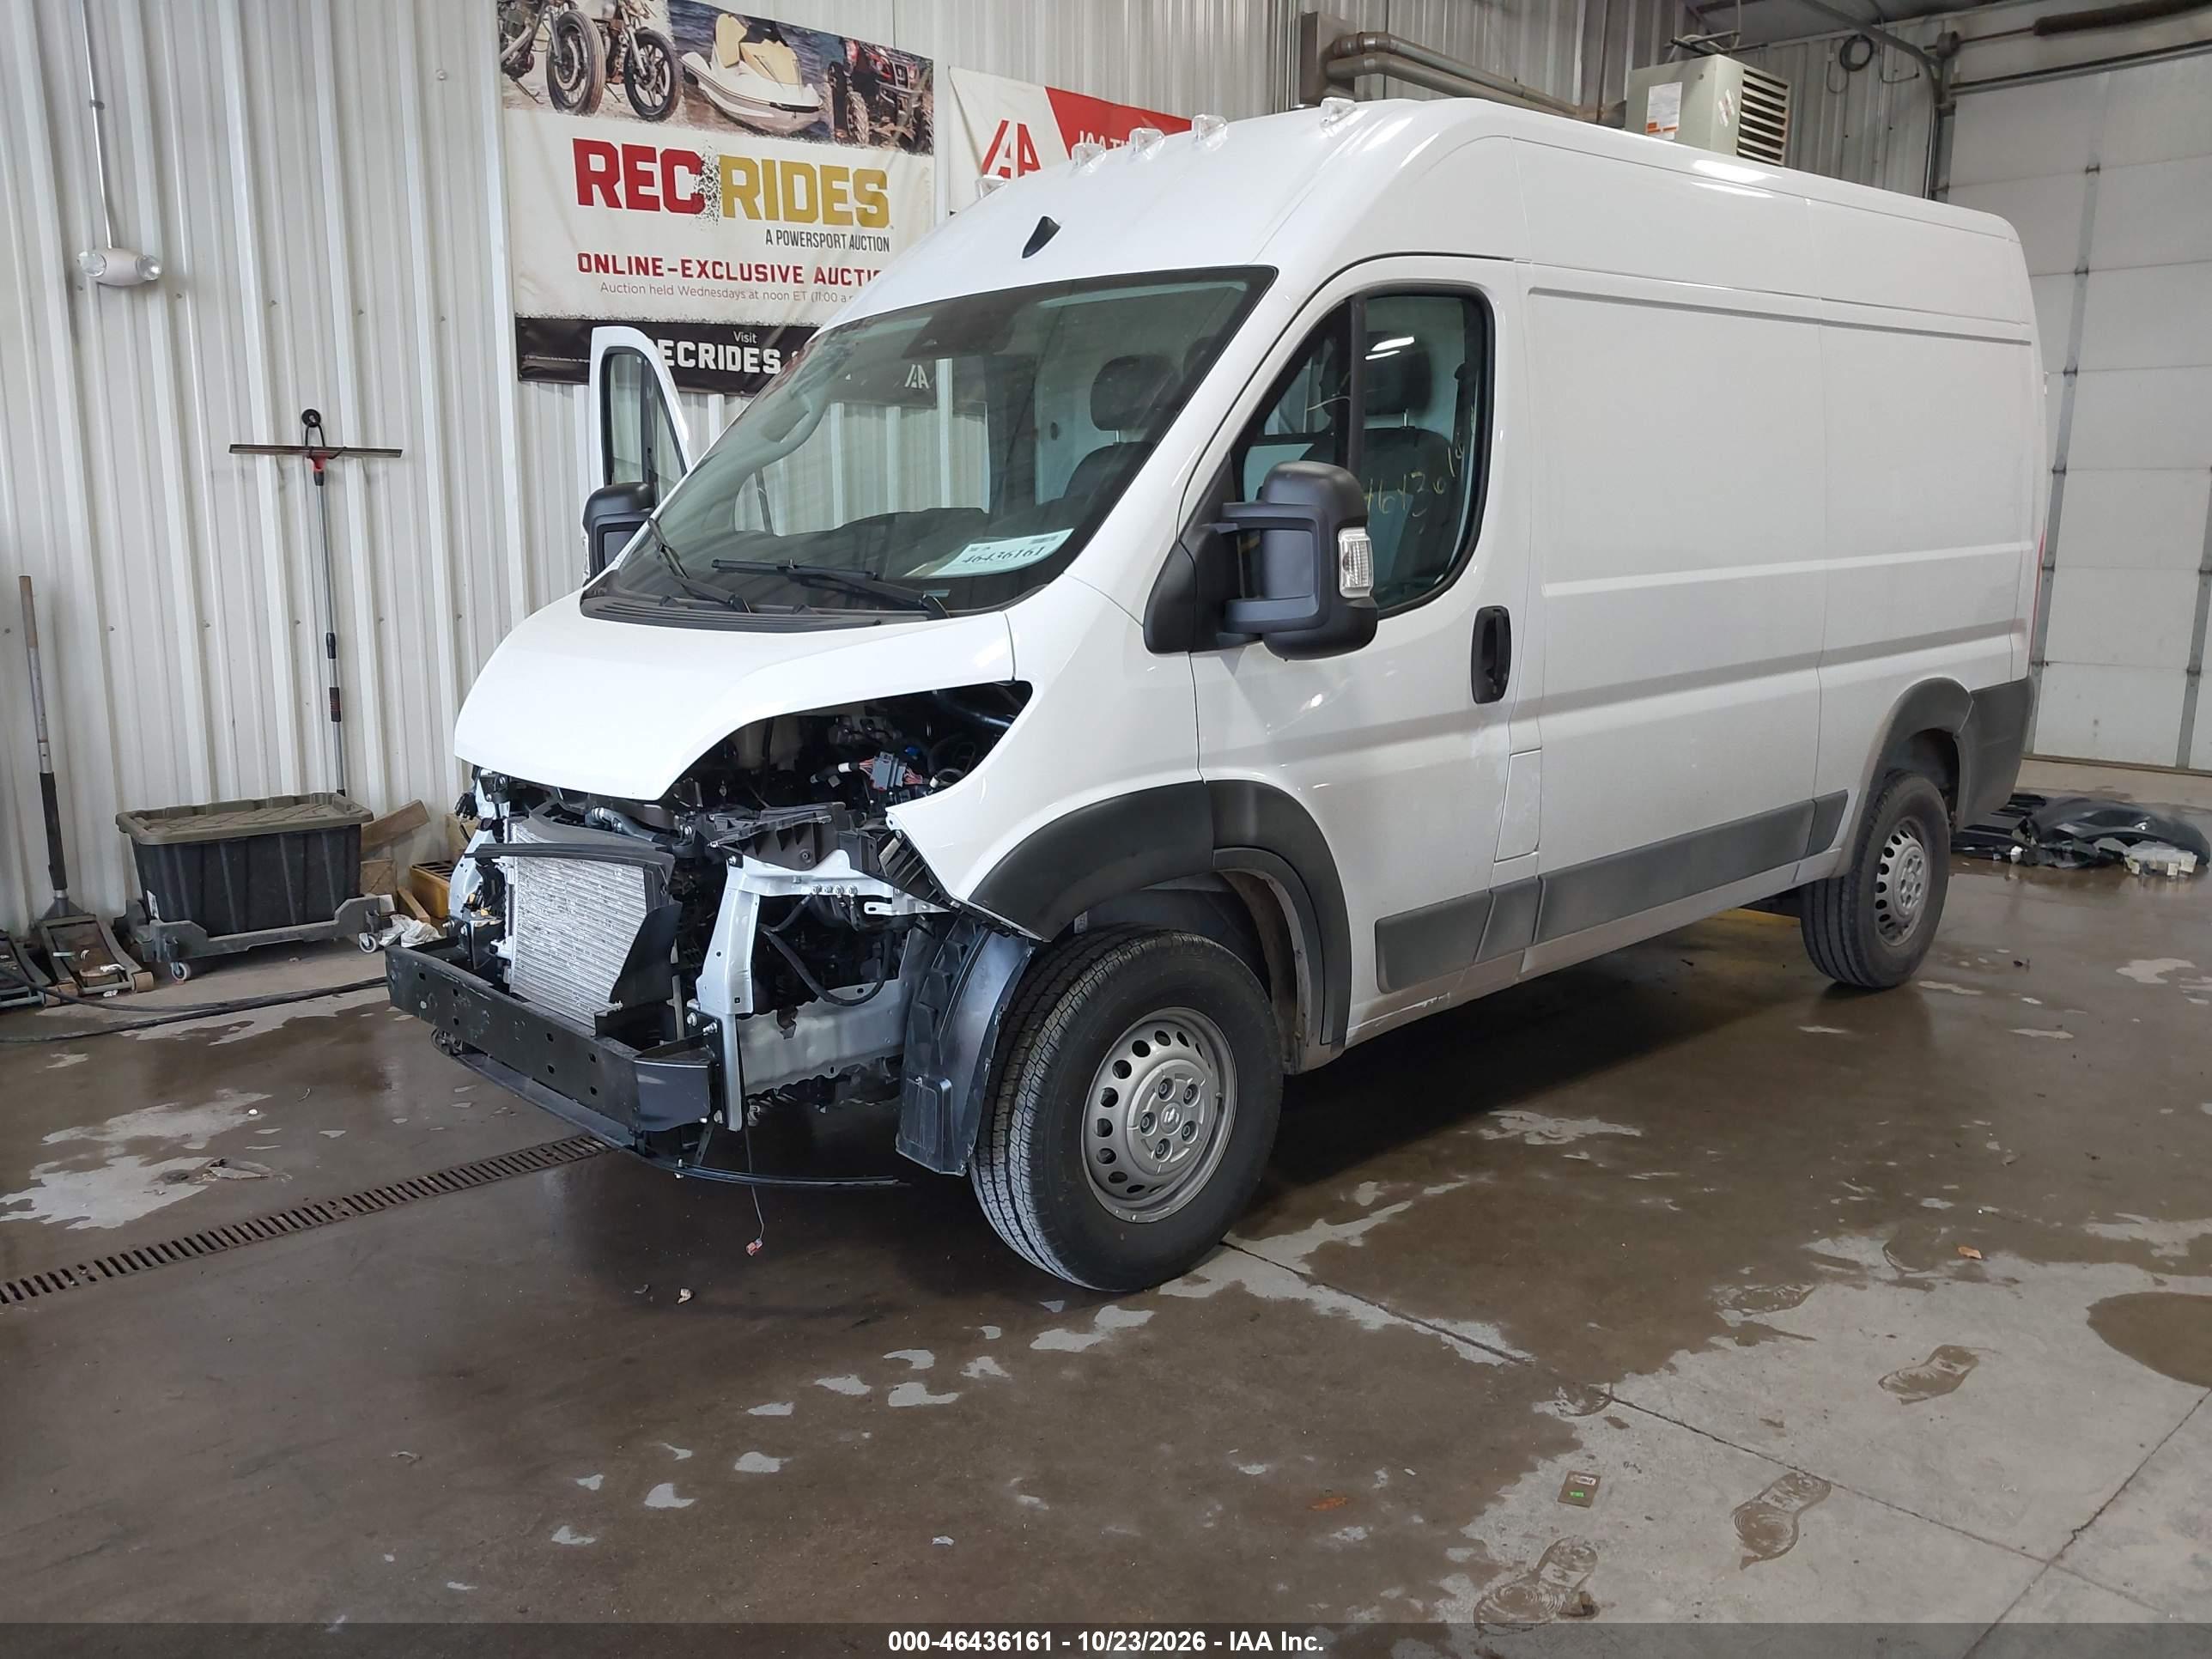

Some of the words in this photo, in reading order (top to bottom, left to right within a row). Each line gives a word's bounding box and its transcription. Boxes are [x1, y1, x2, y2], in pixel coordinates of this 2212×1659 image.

[765, 229, 773, 245] A
[775, 229, 848, 249] POWERSPORT
[848, 234, 890, 252] AUCTION
[576, 252, 805, 285] ONLINE-EXCLUSIVE
[600, 281, 645, 295] Auction
[649, 285, 674, 296] held
[677, 285, 746, 301] Wednesdays
[748, 290, 760, 300] at
[763, 291, 789, 301] noon
[793, 291, 807, 301] ET
[811, 292, 838, 303] (11:00
[733, 331, 758, 343] Visit
[648, 338, 781, 375] ECRIDES
